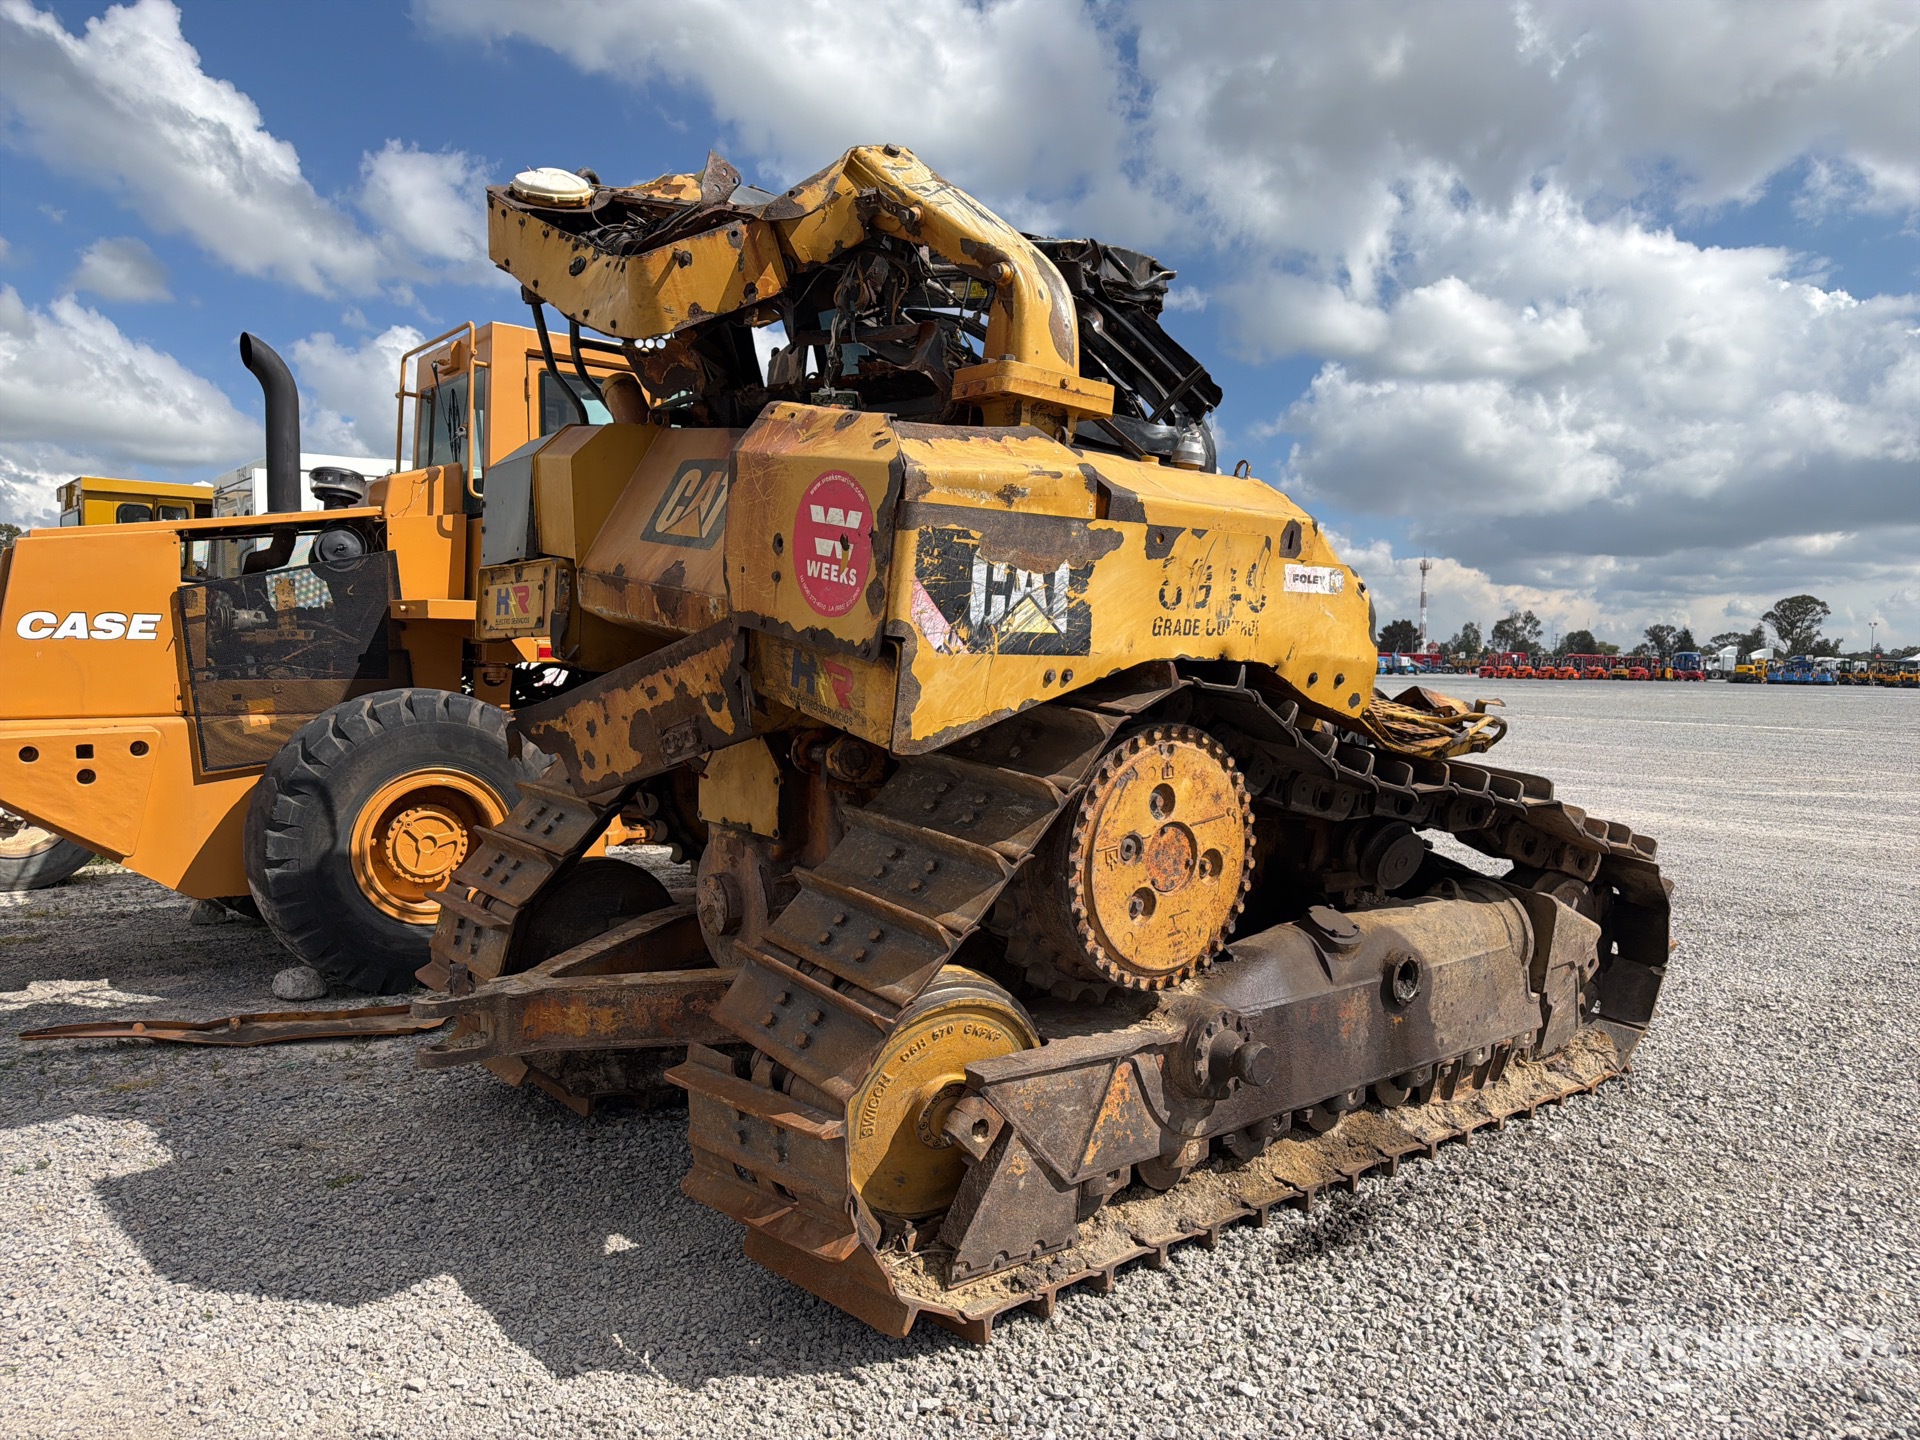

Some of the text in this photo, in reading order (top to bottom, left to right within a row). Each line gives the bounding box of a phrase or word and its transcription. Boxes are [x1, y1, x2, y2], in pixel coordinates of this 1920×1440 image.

[655, 468, 729, 538] CAT
[806, 559, 857, 587] WEEKS
[1292, 573, 1326, 585] FOLEY
[16, 610, 163, 640] CASE
[1152, 616, 1200, 637] GRADE
